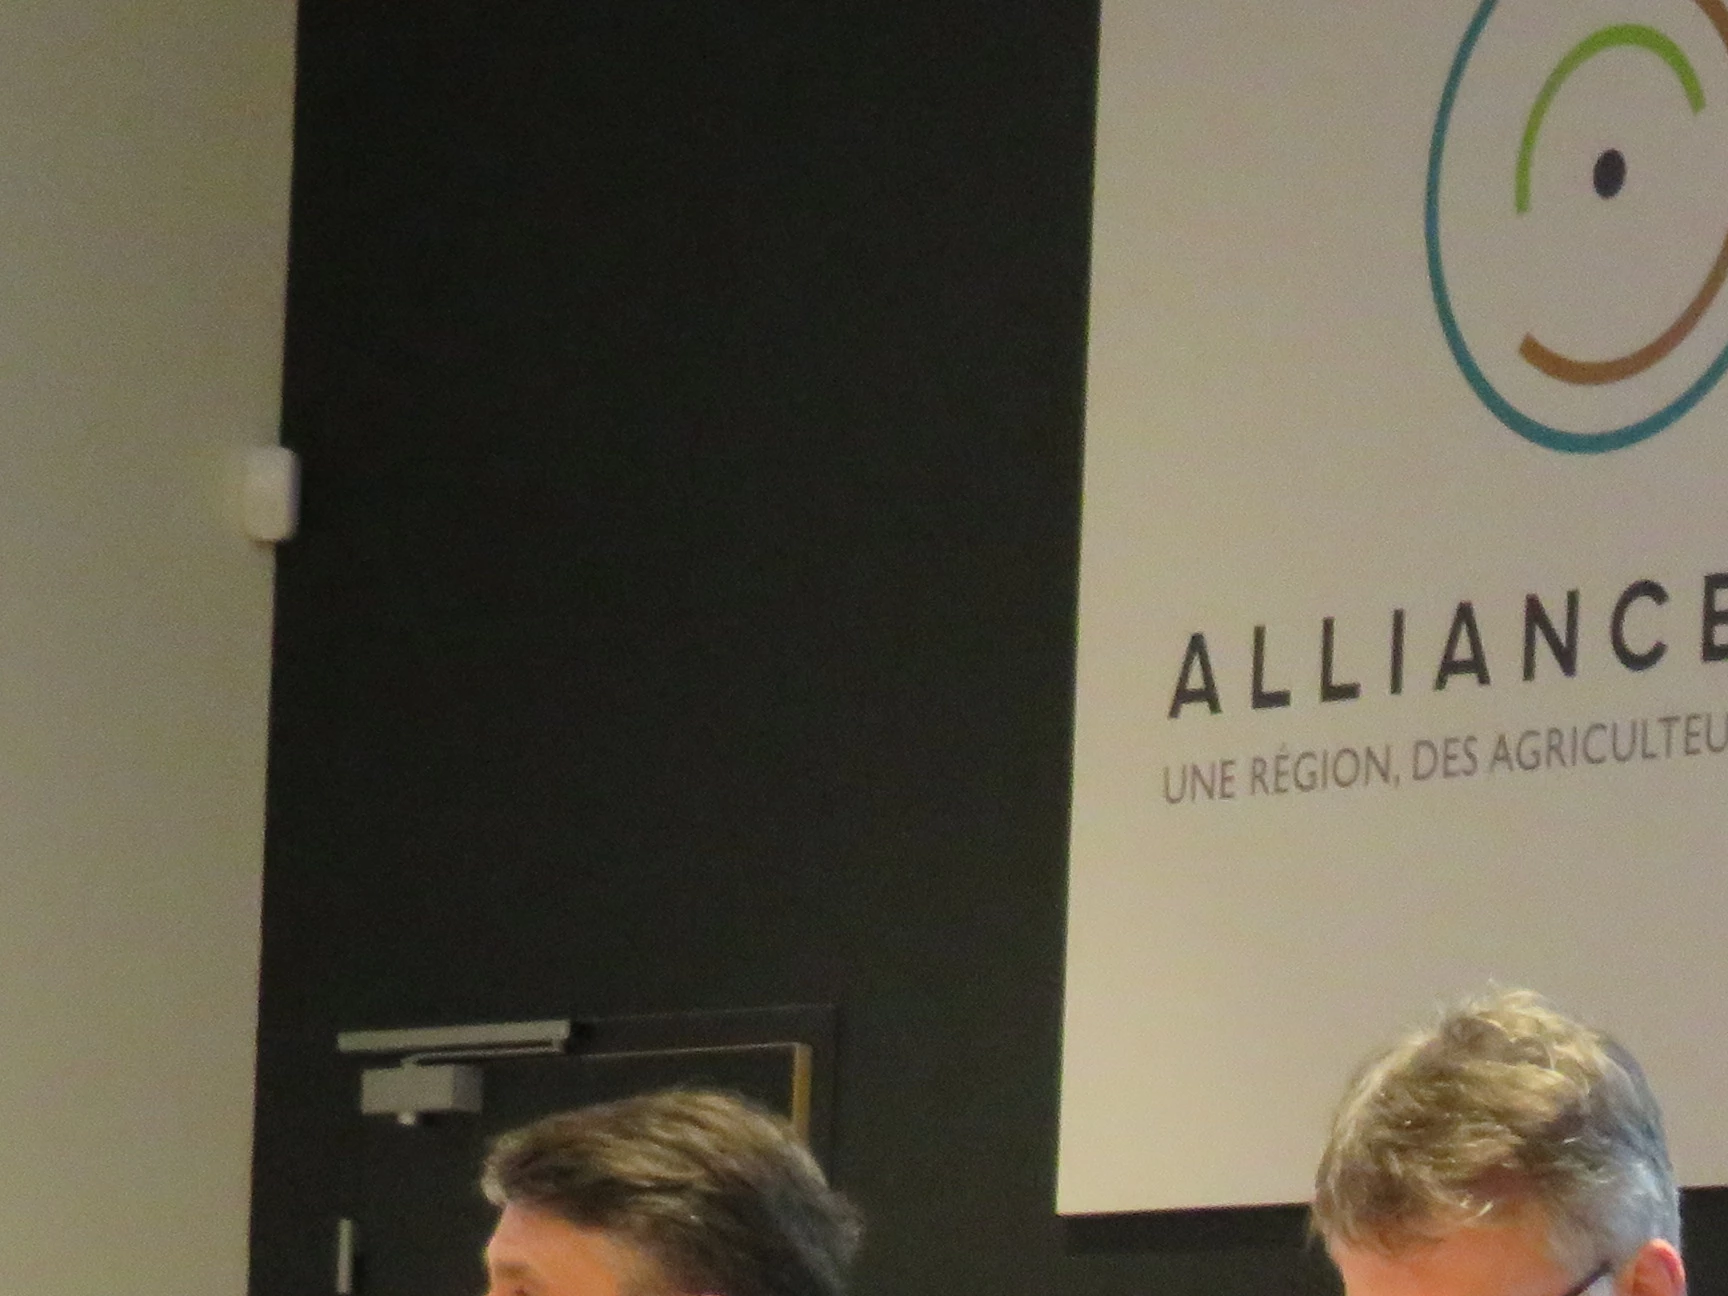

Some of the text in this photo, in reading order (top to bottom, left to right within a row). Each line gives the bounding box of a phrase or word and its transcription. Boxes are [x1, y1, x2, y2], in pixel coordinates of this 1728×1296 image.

[1162, 759, 1236, 804] UNE
[1249, 742, 1400, 796] RÉGION,
[1411, 735, 1478, 781] DES
